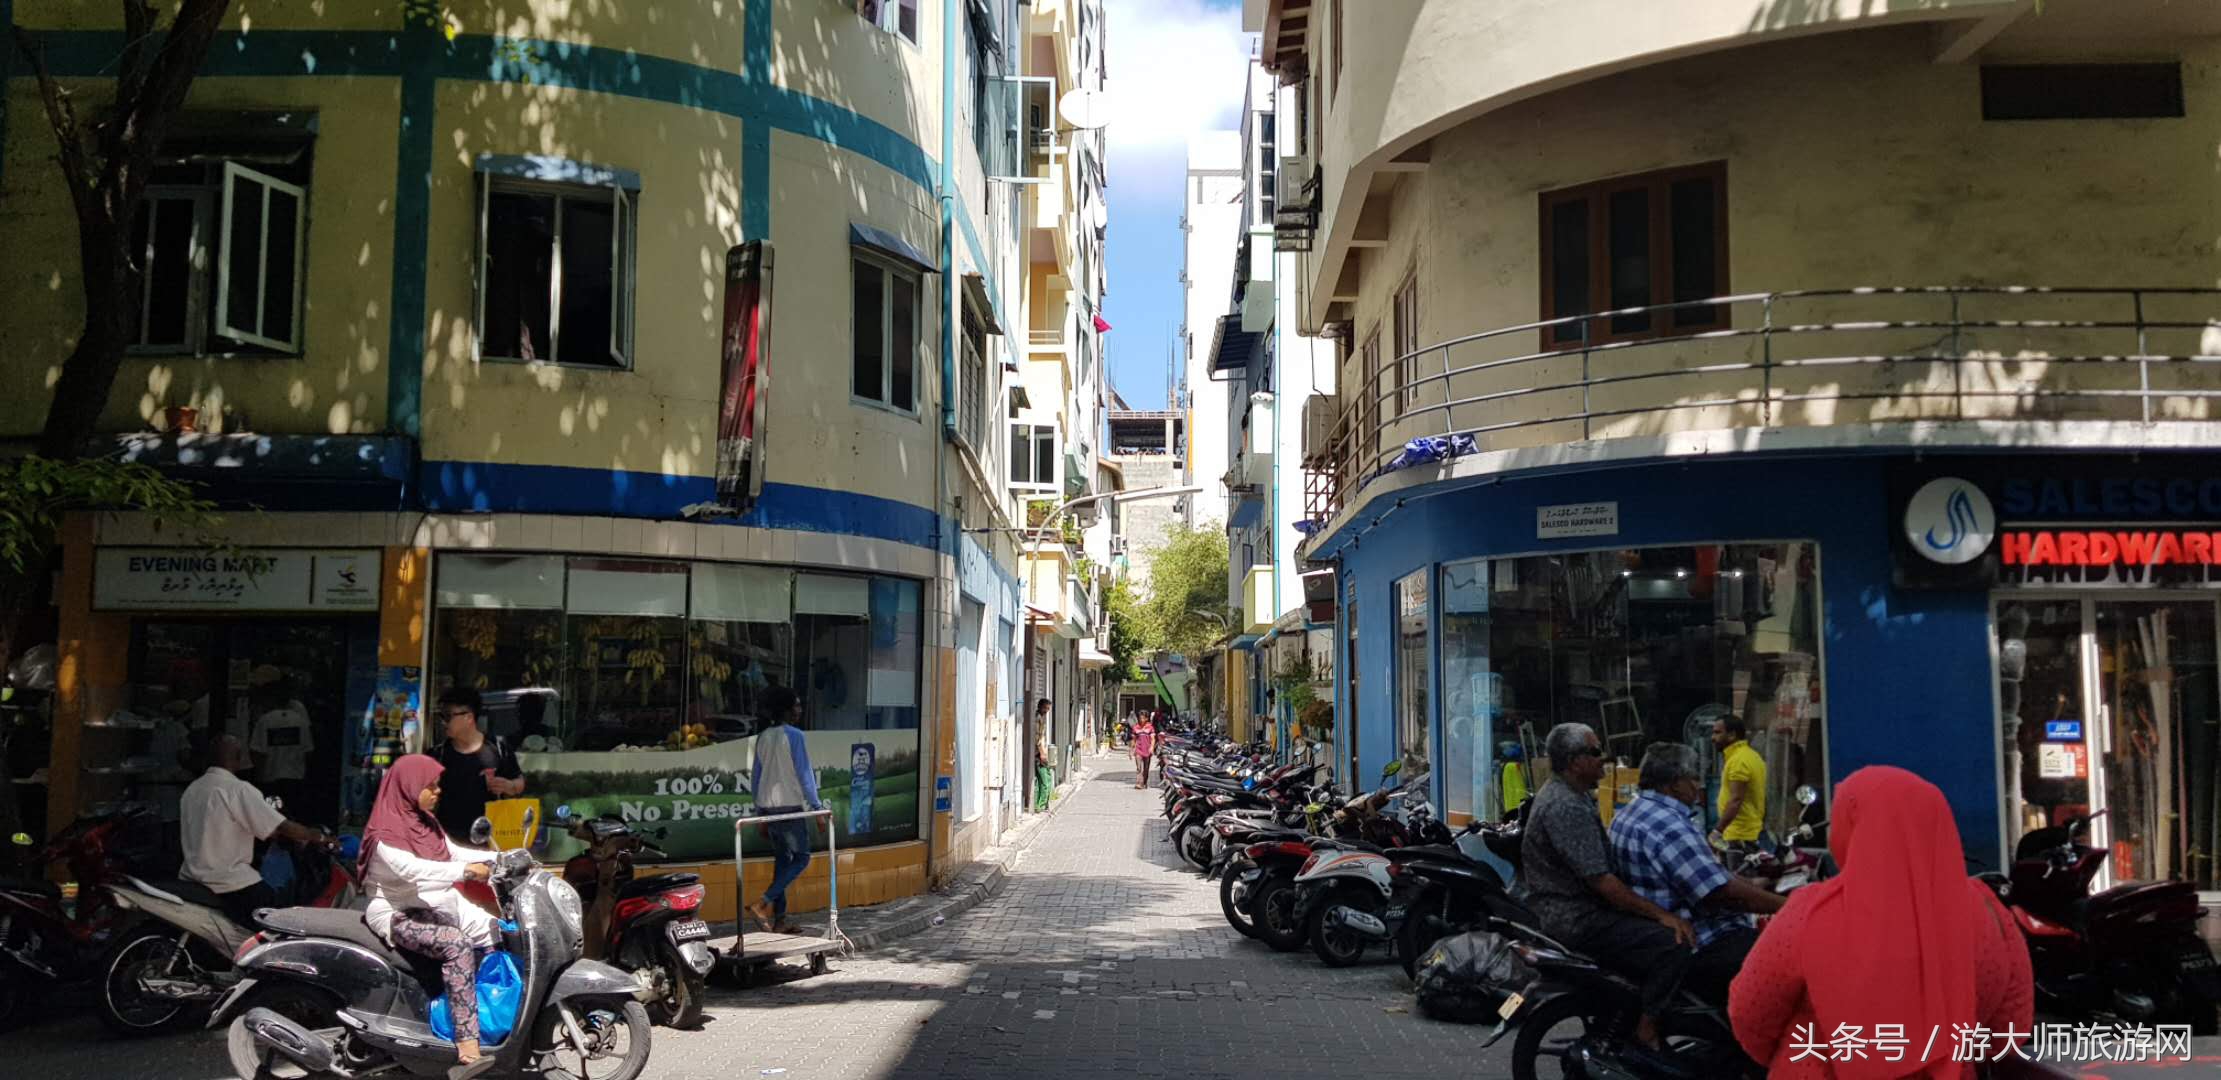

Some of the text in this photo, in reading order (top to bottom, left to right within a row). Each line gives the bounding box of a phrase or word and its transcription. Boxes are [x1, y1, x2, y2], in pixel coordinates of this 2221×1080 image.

[2004, 479, 2221, 513] SALESCO
[129, 557, 217, 573] EVENING
[654, 773, 724, 796] 100%
[620, 801, 661, 822] No
